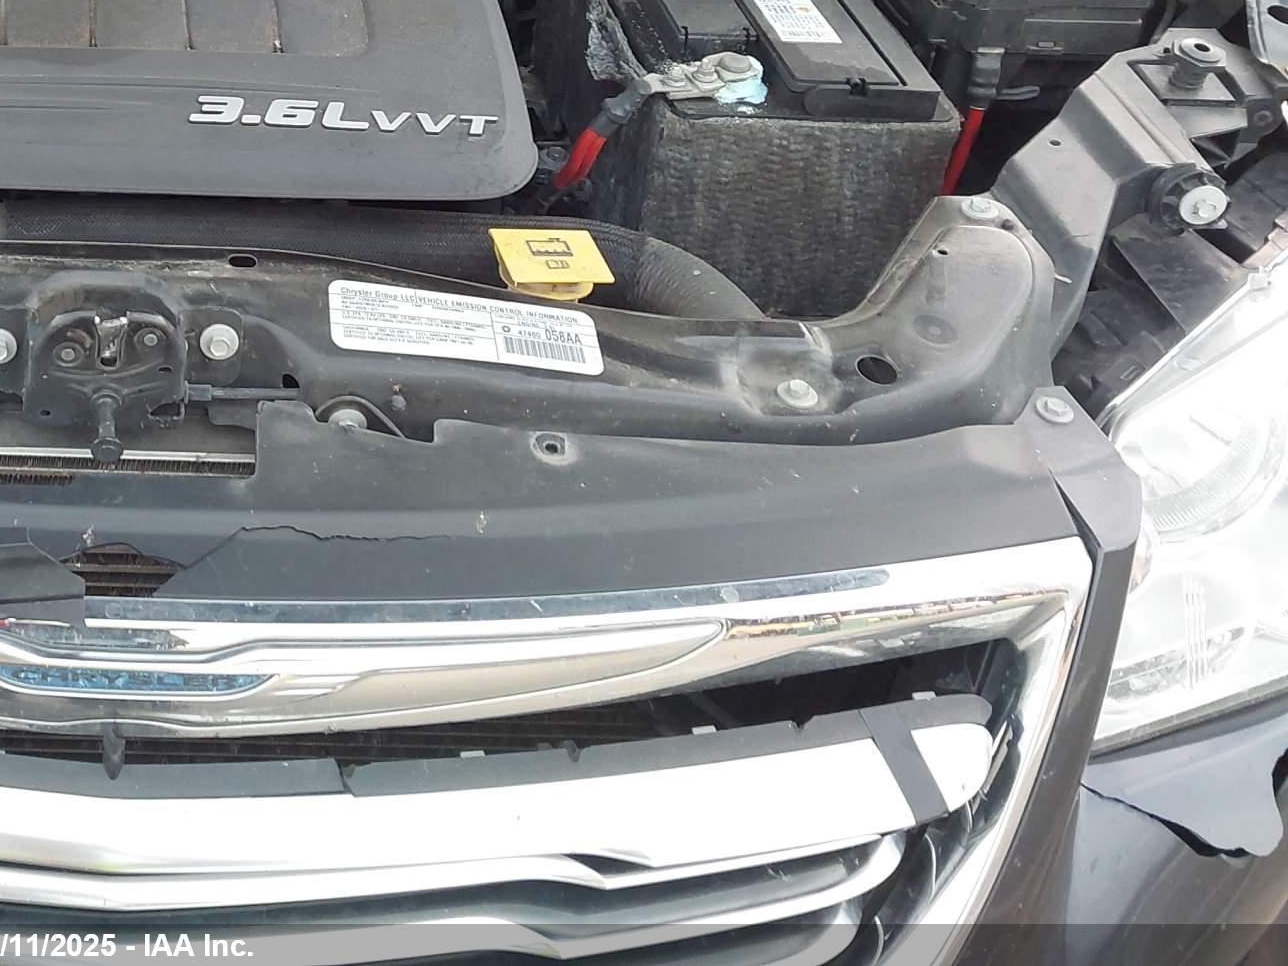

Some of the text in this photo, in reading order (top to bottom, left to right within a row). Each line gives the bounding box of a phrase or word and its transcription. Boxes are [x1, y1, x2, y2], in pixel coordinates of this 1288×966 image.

[340, 286, 372, 297] Chrysler
[375, 290, 398, 301] Group
[417, 295, 448, 306] VEHICLE
[450, 299, 487, 311] EMISSION
[489, 305, 522, 315] CONTROL
[526, 310, 578, 323] INFORMATION
[544, 327, 583, 345] 058AA
